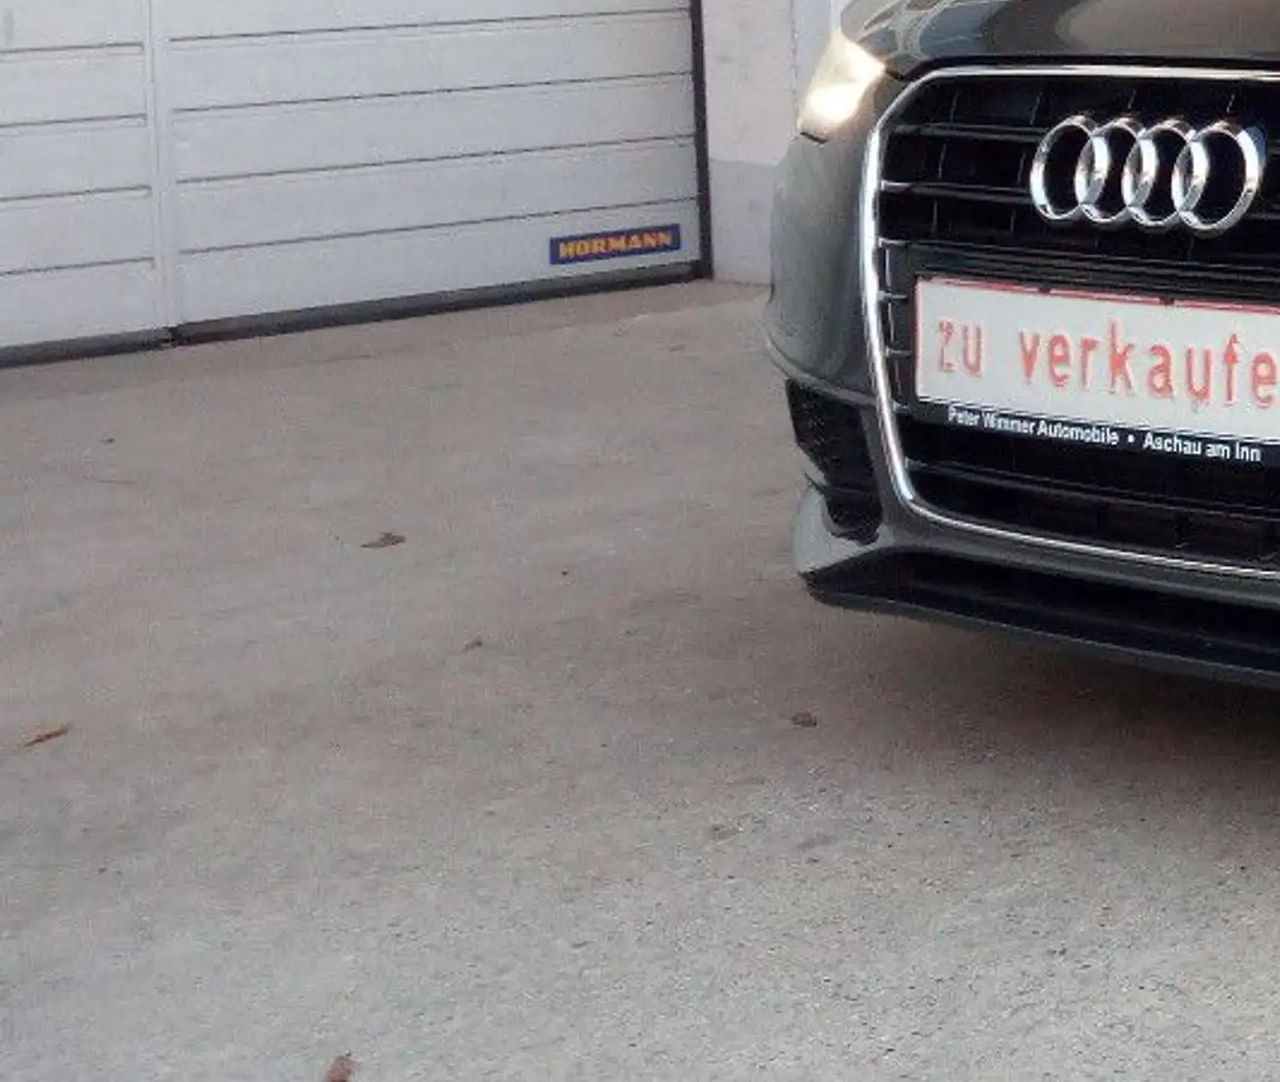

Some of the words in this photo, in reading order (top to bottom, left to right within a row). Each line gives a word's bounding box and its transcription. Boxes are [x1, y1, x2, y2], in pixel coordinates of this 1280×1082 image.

[937, 320, 982, 378] zu
[947, 408, 981, 427] Peter
[983, 411, 1036, 436] Wimmer
[1036, 419, 1120, 447] Automobile
[1142, 431, 1202, 456] Aschau
[1205, 442, 1231, 459] am
[1234, 444, 1263, 463] Inn
